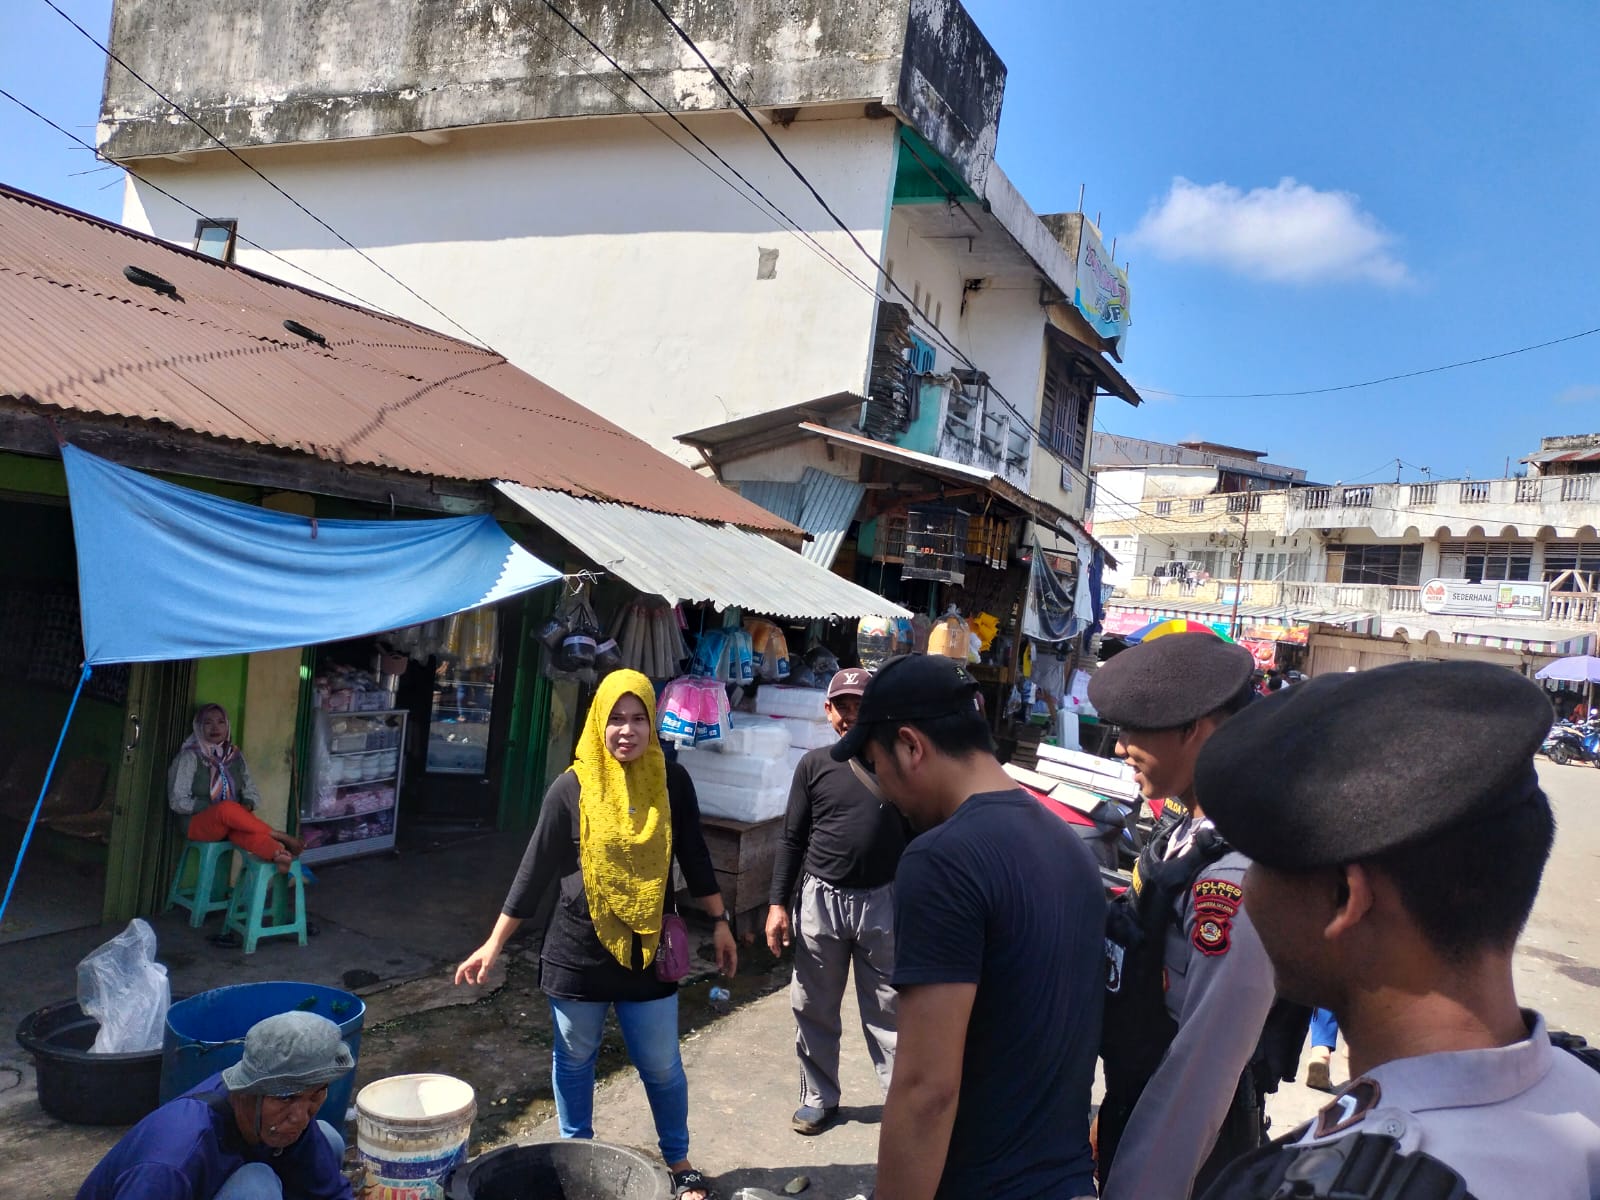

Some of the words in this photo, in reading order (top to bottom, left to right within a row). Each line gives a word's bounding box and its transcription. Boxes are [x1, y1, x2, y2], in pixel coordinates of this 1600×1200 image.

[1452, 592, 1493, 602] SEDERHANA
[1164, 797, 1182, 815] POLDA
[1195, 881, 1242, 897] POLRES
[1202, 889, 1232, 898] PALI
